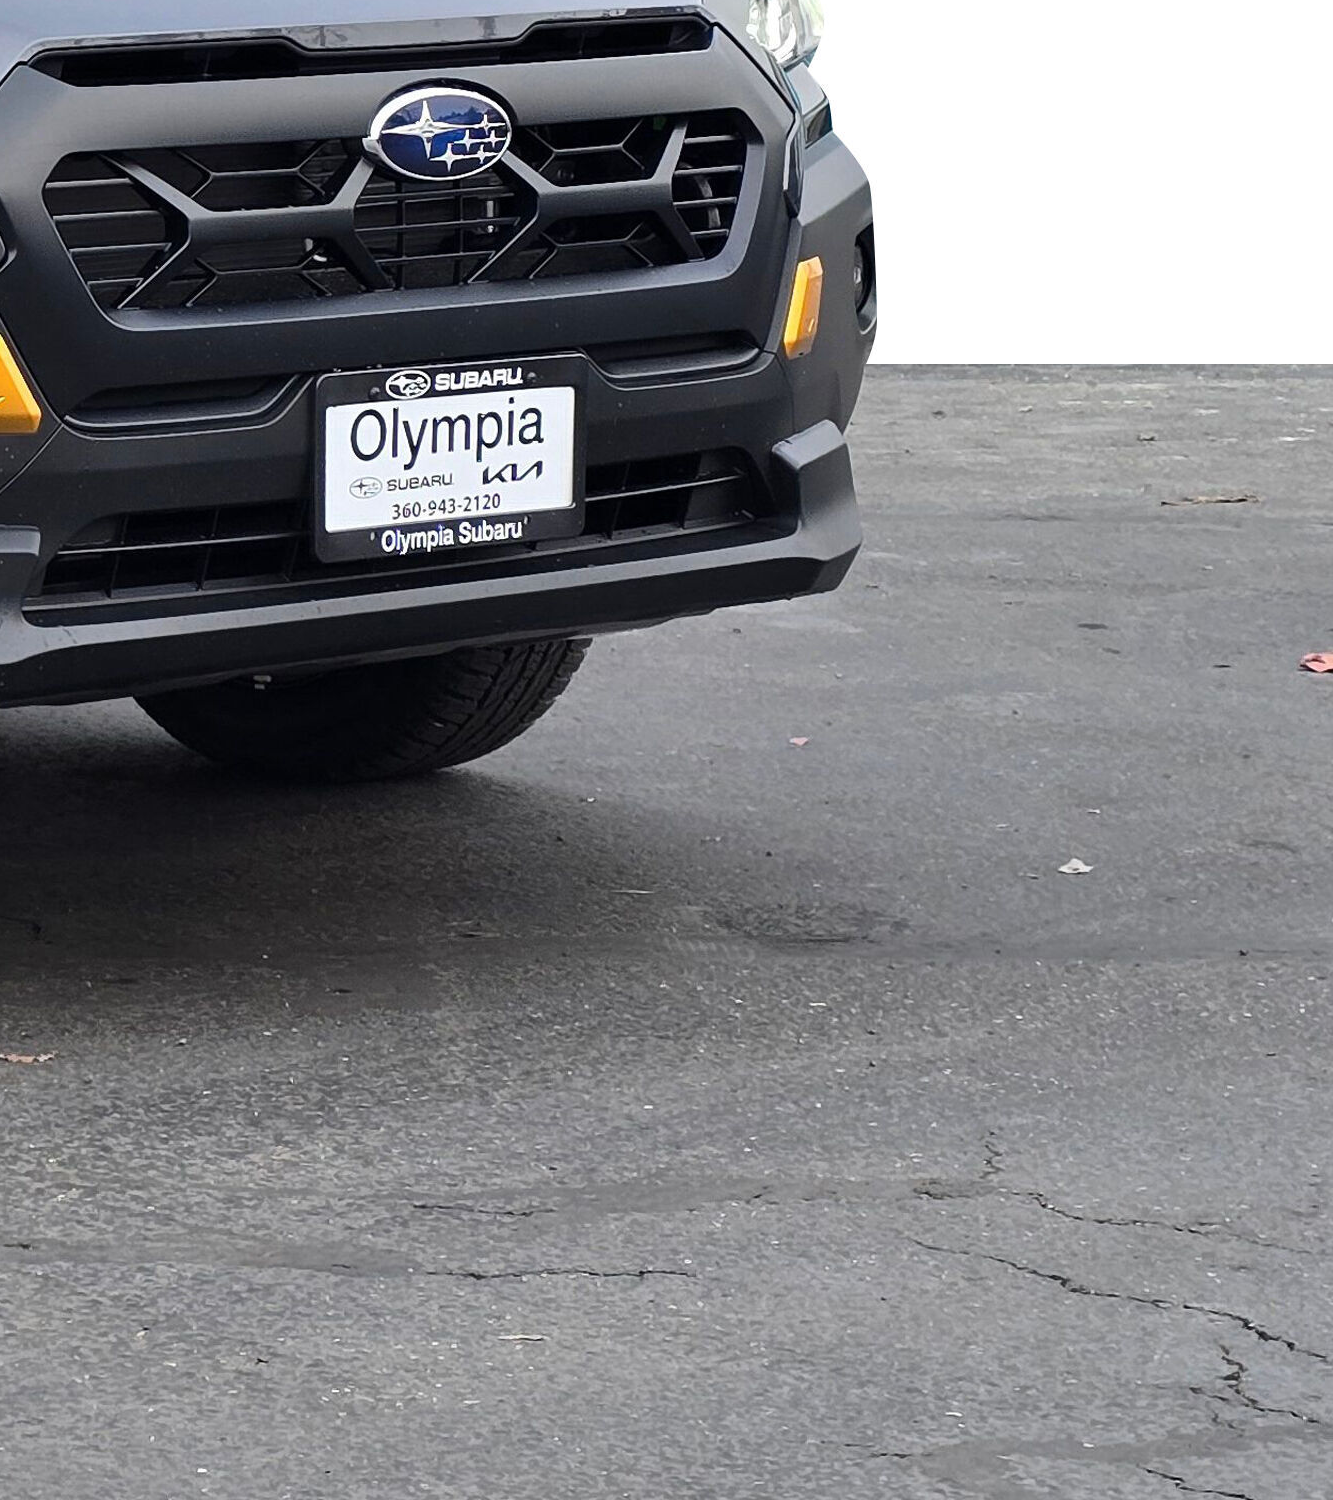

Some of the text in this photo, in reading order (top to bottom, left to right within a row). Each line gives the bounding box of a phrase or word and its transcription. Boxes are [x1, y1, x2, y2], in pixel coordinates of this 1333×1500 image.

[434, 367, 524, 391] SUBARU
[349, 396, 545, 471] Olympia
[386, 473, 453, 492] SUBARU
[391, 493, 502, 520] 360-943-2120
[380, 520, 524, 555] Olympia Subaru
